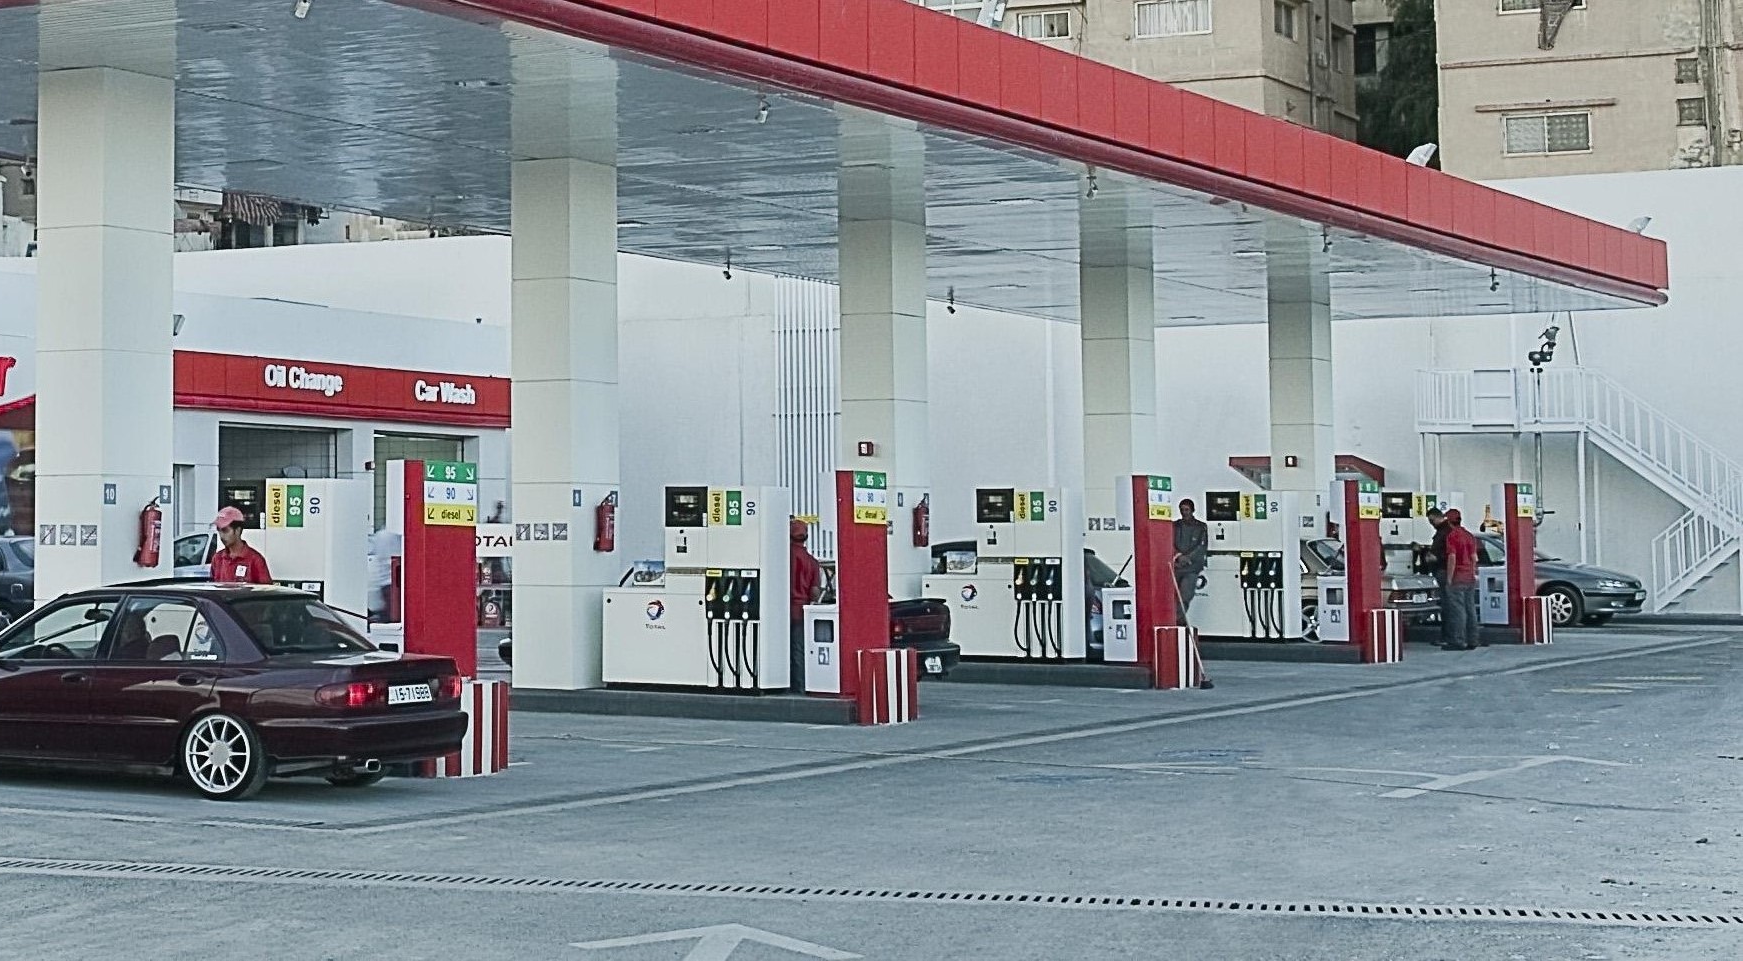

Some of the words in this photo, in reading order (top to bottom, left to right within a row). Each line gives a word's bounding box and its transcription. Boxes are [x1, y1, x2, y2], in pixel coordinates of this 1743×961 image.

[264, 364, 286, 387] Oil
[288, 365, 343, 397] Change
[414, 380, 439, 402] Car
[439, 381, 476, 405] Wash
[445, 465, 456, 480] 95
[105, 488, 115, 500] 10
[162, 488, 169, 500] 9
[446, 487, 455, 499] 90
[271, 488, 280, 524] diesel
[289, 496, 302, 516] 95
[310, 497, 320, 514] 90
[712, 493, 721, 522] diesel
[729, 500, 739, 516] 95
[746, 501, 756, 516] 90
[1032, 500, 1042, 513] 95
[1048, 500, 1058, 512] 90
[441, 509, 461, 520] diesel
